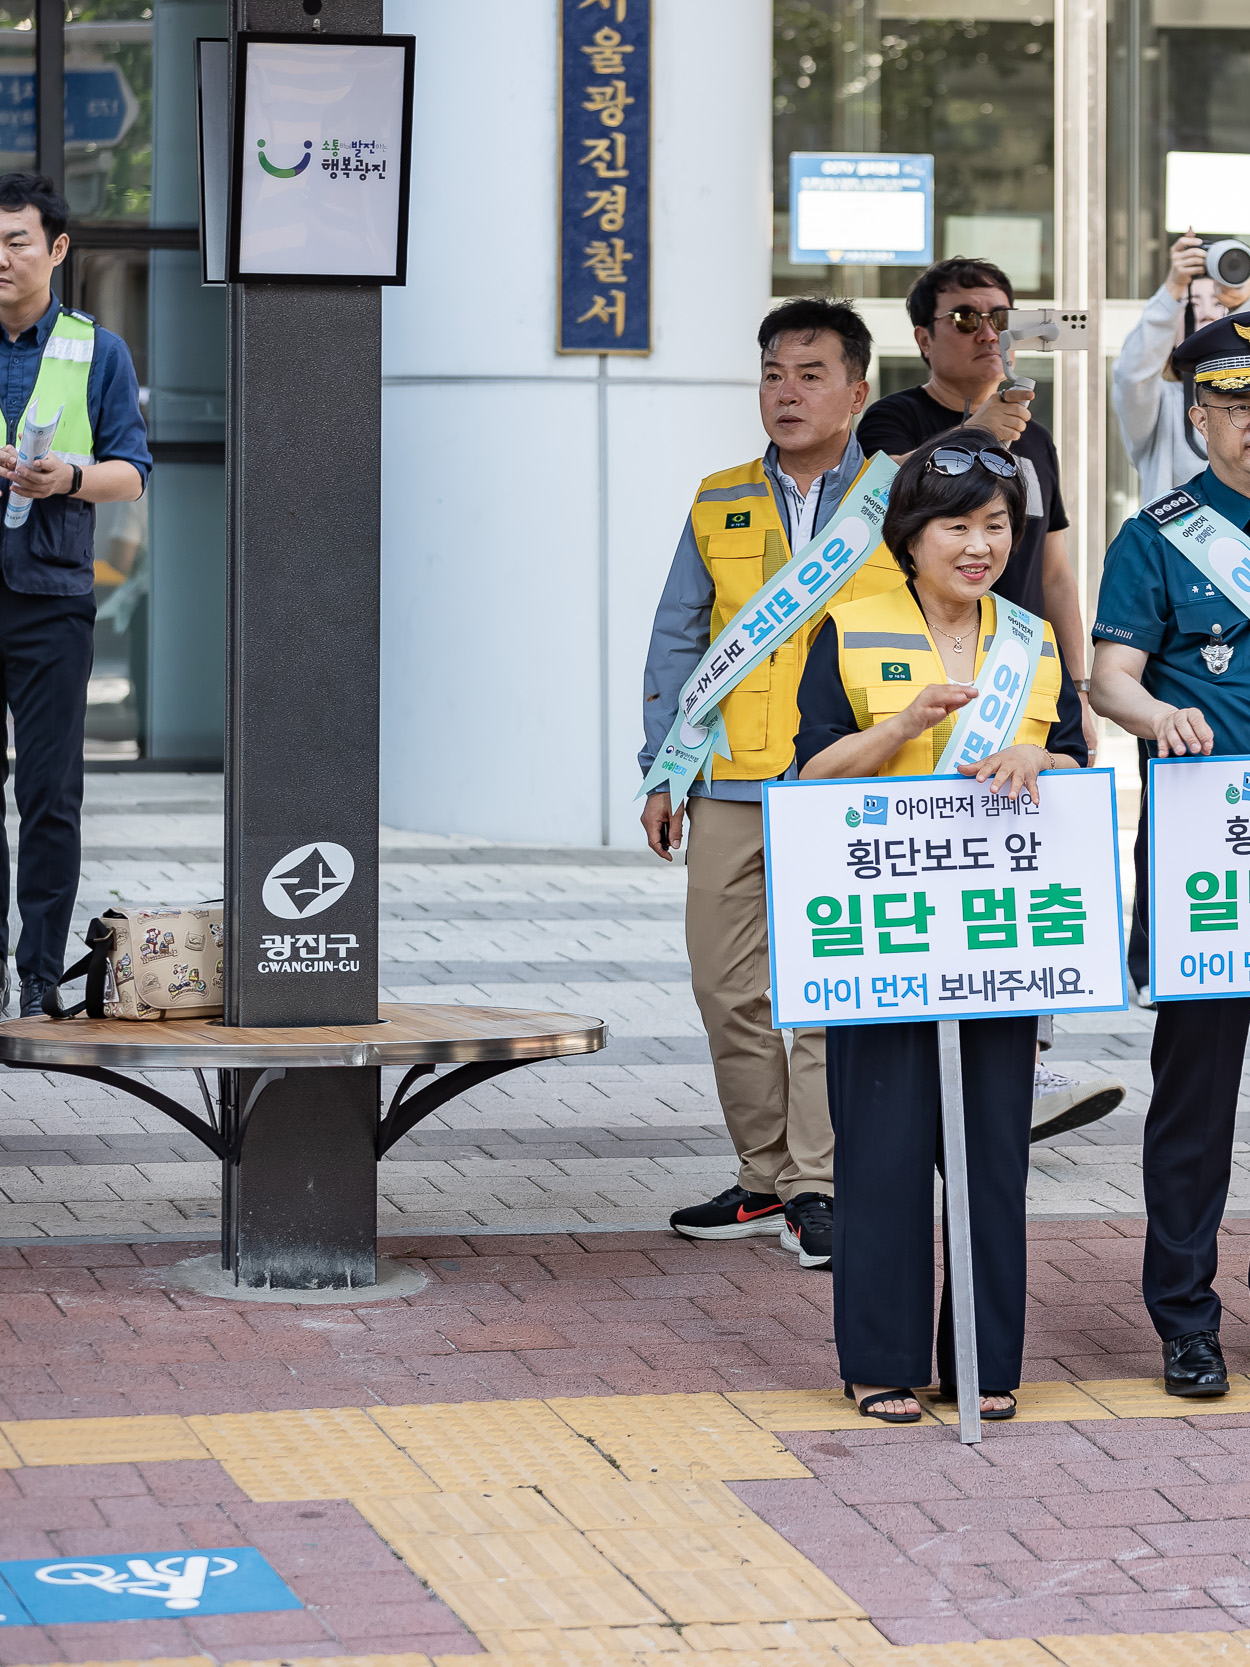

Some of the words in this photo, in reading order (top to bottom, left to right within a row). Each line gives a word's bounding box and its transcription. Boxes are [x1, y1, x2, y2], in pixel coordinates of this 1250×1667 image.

[321, 157, 386, 181] 행복광진
[1182, 514, 1209, 538] 아이먼저
[1194, 524, 1217, 544] 캠페인
[797, 537, 854, 596] 아이
[741, 586, 801, 647] 먼저
[1007, 614, 1034, 638] 아이먼저
[1011, 625, 1031, 645] 캠페인
[979, 664, 1021, 730] 아이
[953, 730, 994, 769] 먼
[896, 795, 975, 820] 아이먼저
[980, 793, 1040, 817] 캠페인
[846, 837, 994, 880] 횡단보도
[1005, 831, 1042, 873] 앞
[806, 891, 936, 958] 일단
[962, 882, 1087, 950] 멈춤
[260, 933, 360, 961] 광진구
[257, 961, 360, 973] GWANGJIN-GU
[1180, 951, 1234, 985] 아이
[804, 976, 861, 1011] 아이
[871, 973, 928, 1008] 먼저
[938, 966, 1094, 1002] 보내주세요.
